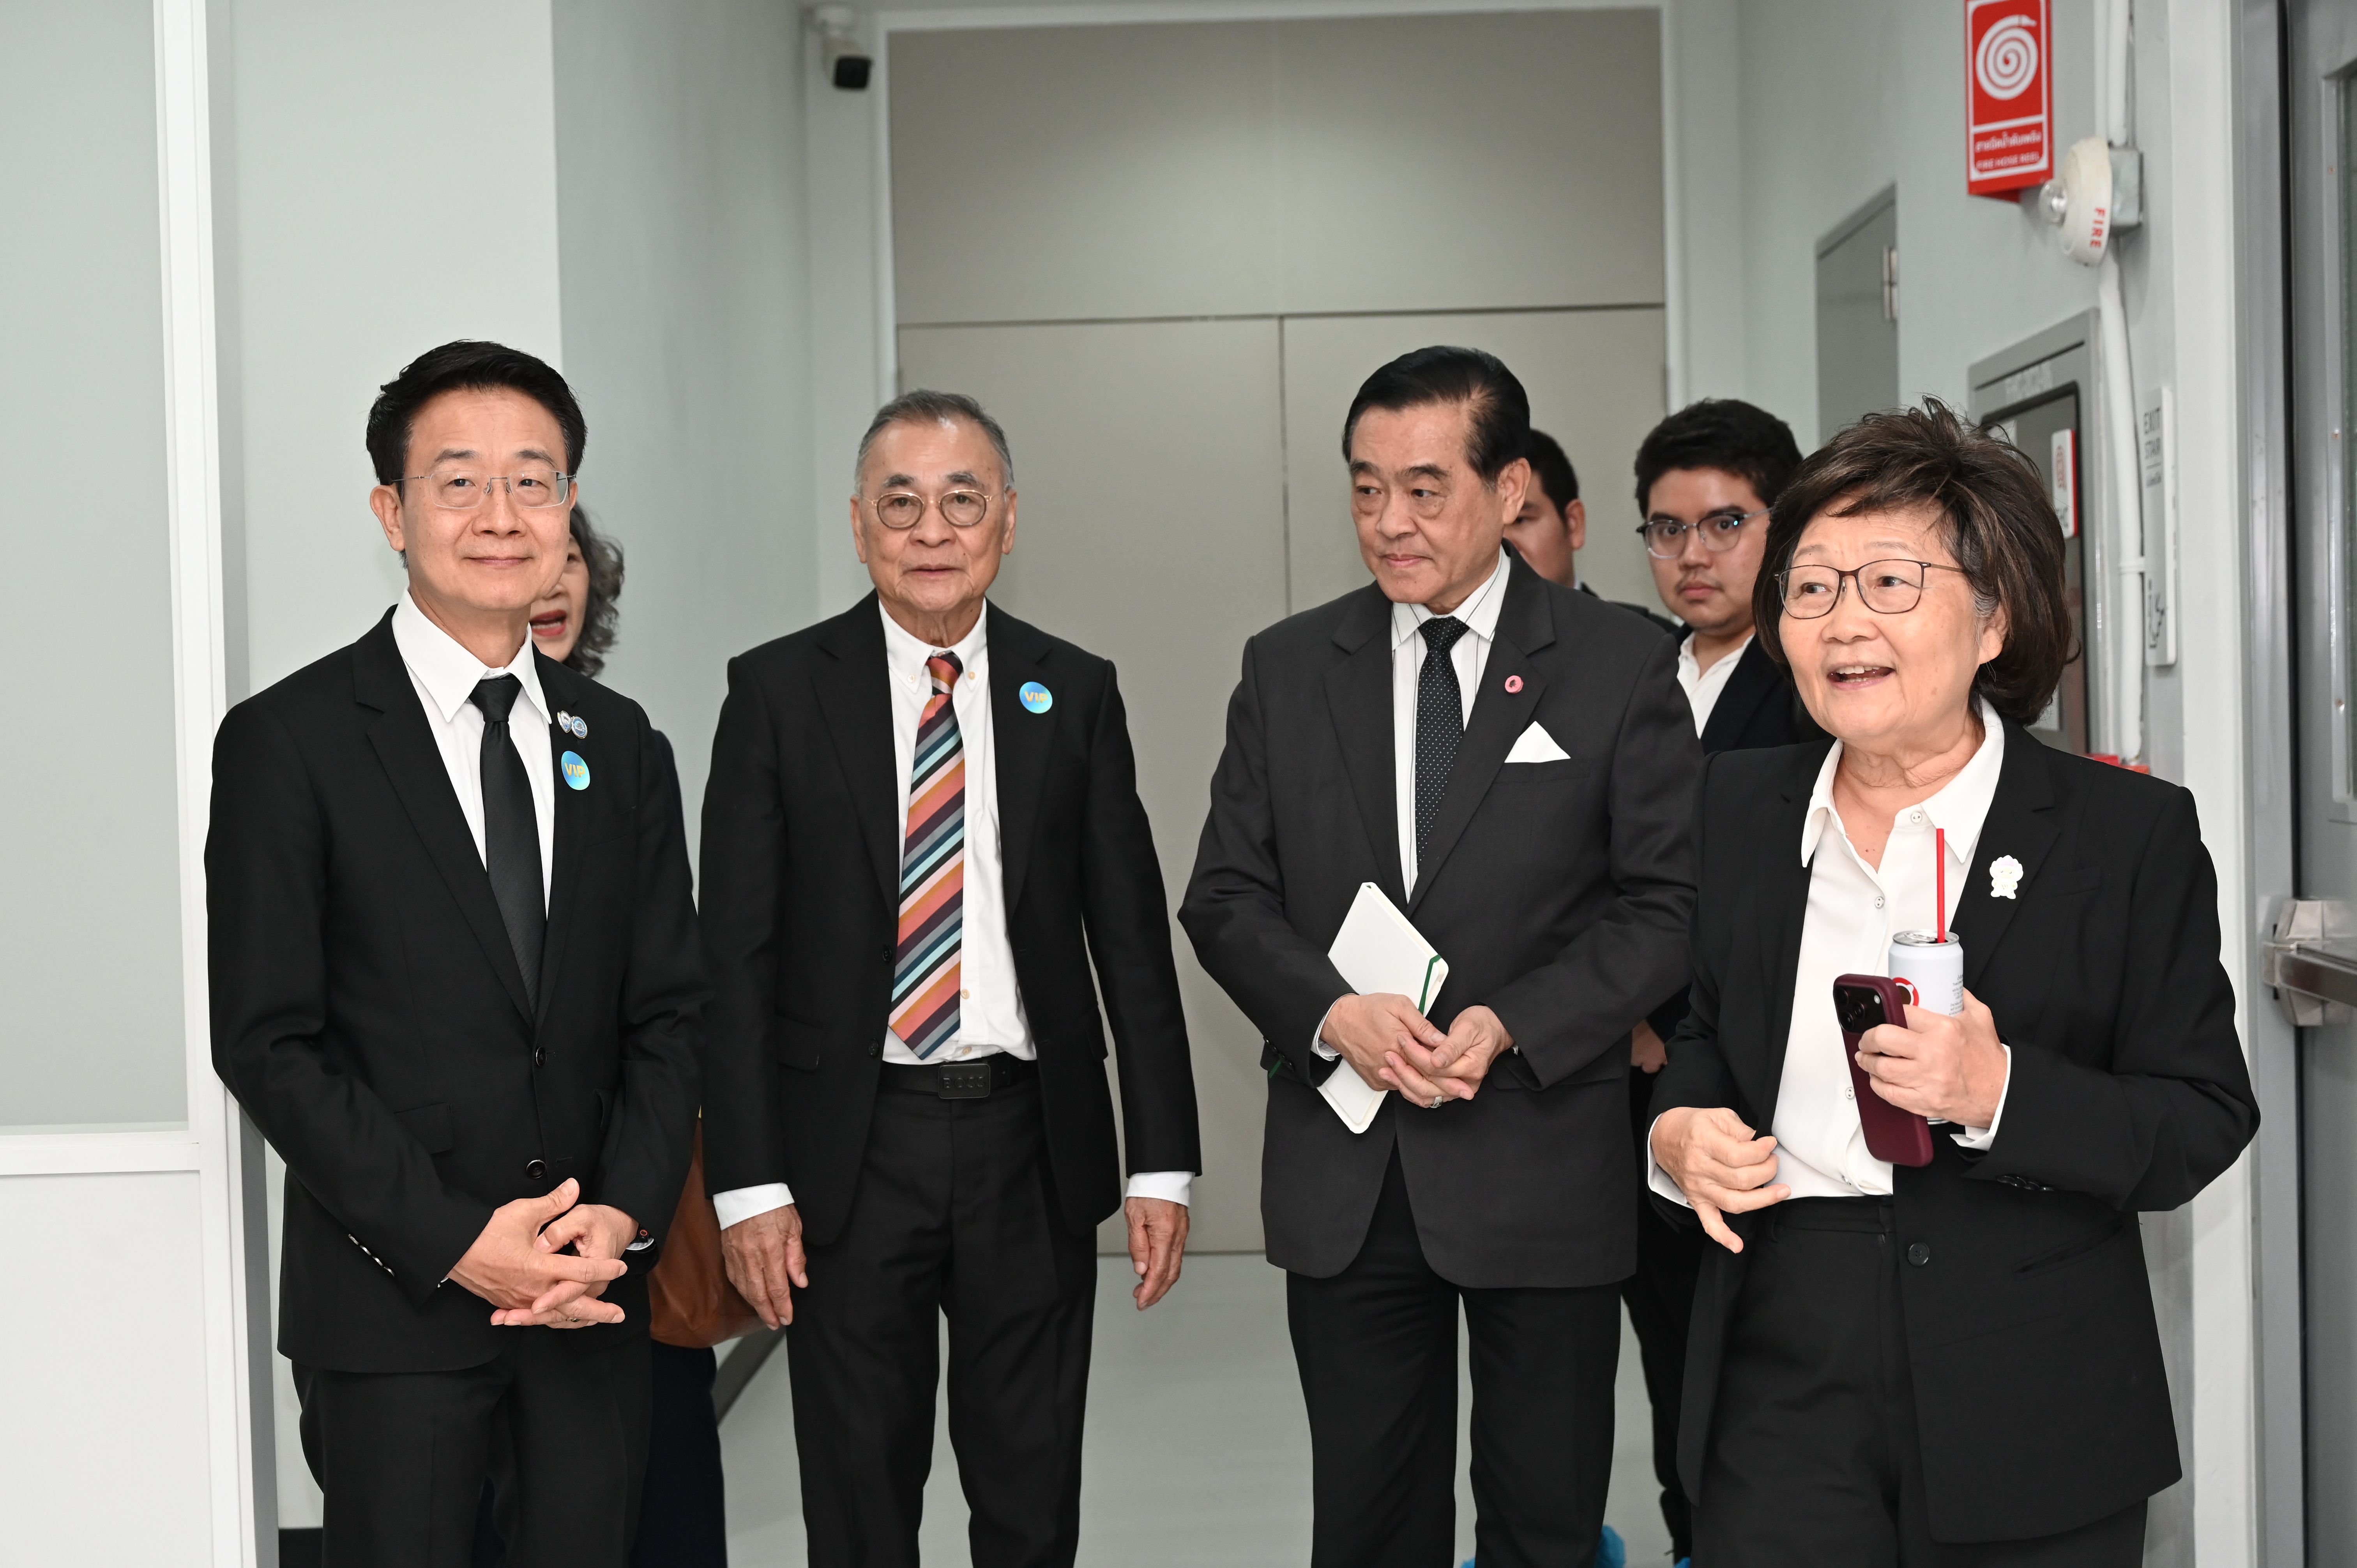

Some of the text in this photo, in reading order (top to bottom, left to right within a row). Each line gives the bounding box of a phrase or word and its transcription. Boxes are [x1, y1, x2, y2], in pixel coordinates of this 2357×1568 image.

[1976, 158, 1994, 170] FIRE
[1995, 154, 2018, 167] HOSE
[2090, 207, 2106, 247] FIRE
[2144, 408, 2161, 434] EXIT
[1025, 691, 1048, 703] VIP
[564, 762, 585, 778] VIP
[943, 1076, 985, 1089] BOSS
